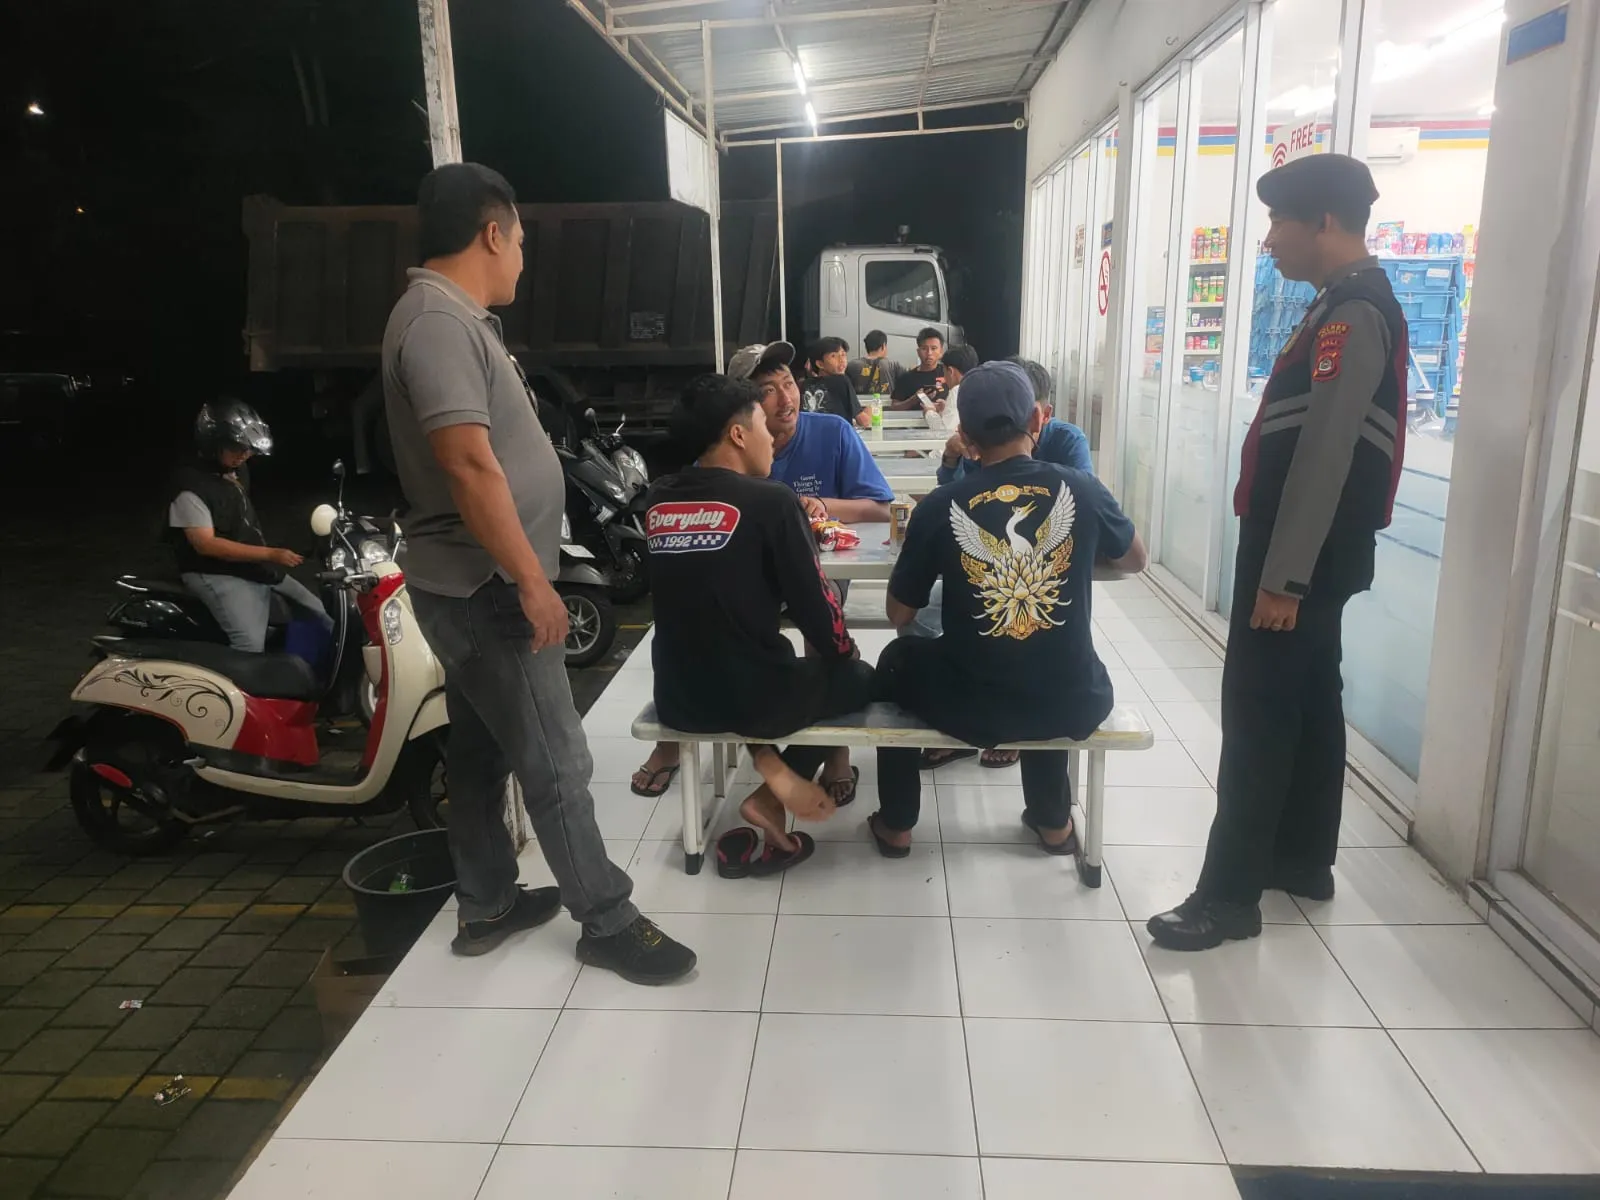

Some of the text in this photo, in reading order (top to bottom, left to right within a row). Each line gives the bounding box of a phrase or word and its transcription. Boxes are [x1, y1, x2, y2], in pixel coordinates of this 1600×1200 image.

[1290, 122, 1313, 152] FREE
[649, 508, 725, 530] Everyday
[663, 535, 692, 547] 1992
